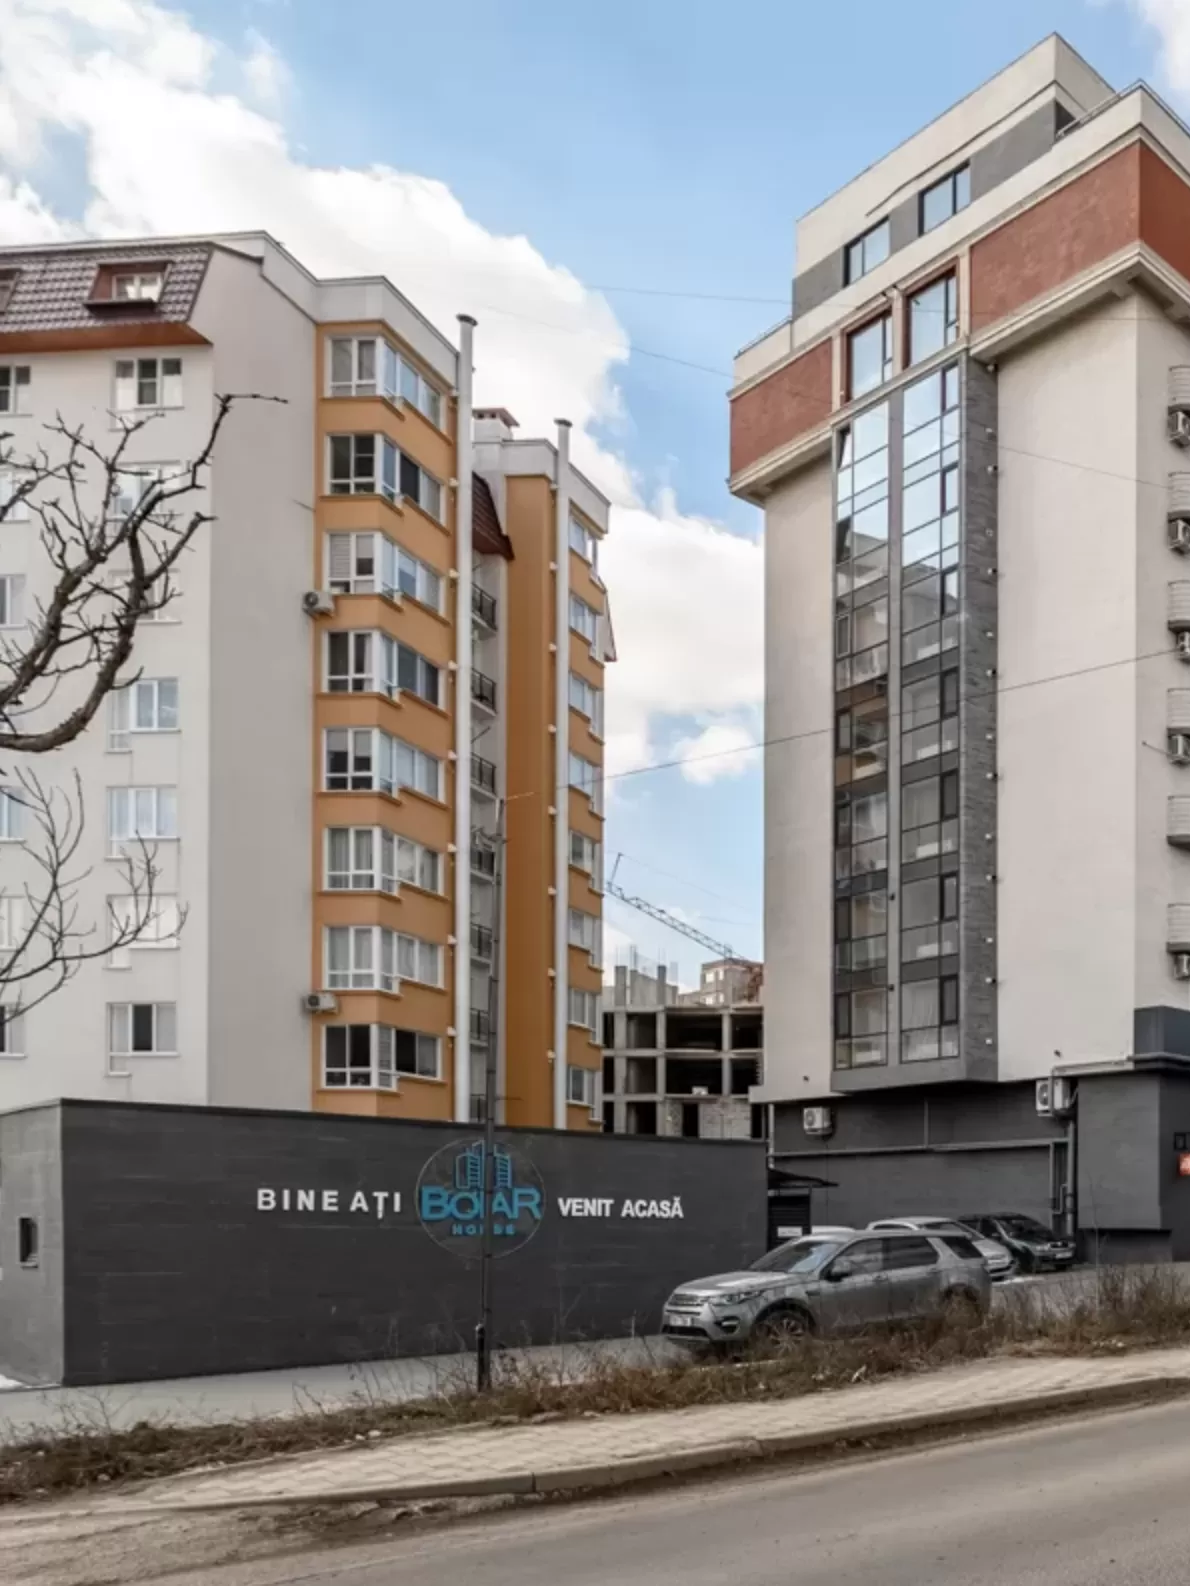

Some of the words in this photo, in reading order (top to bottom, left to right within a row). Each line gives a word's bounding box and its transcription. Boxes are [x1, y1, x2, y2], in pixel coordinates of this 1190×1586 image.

[256, 1187, 339, 1212] BINE
[557, 1197, 614, 1217] VENIT
[621, 1196, 684, 1218] ACASĂ
